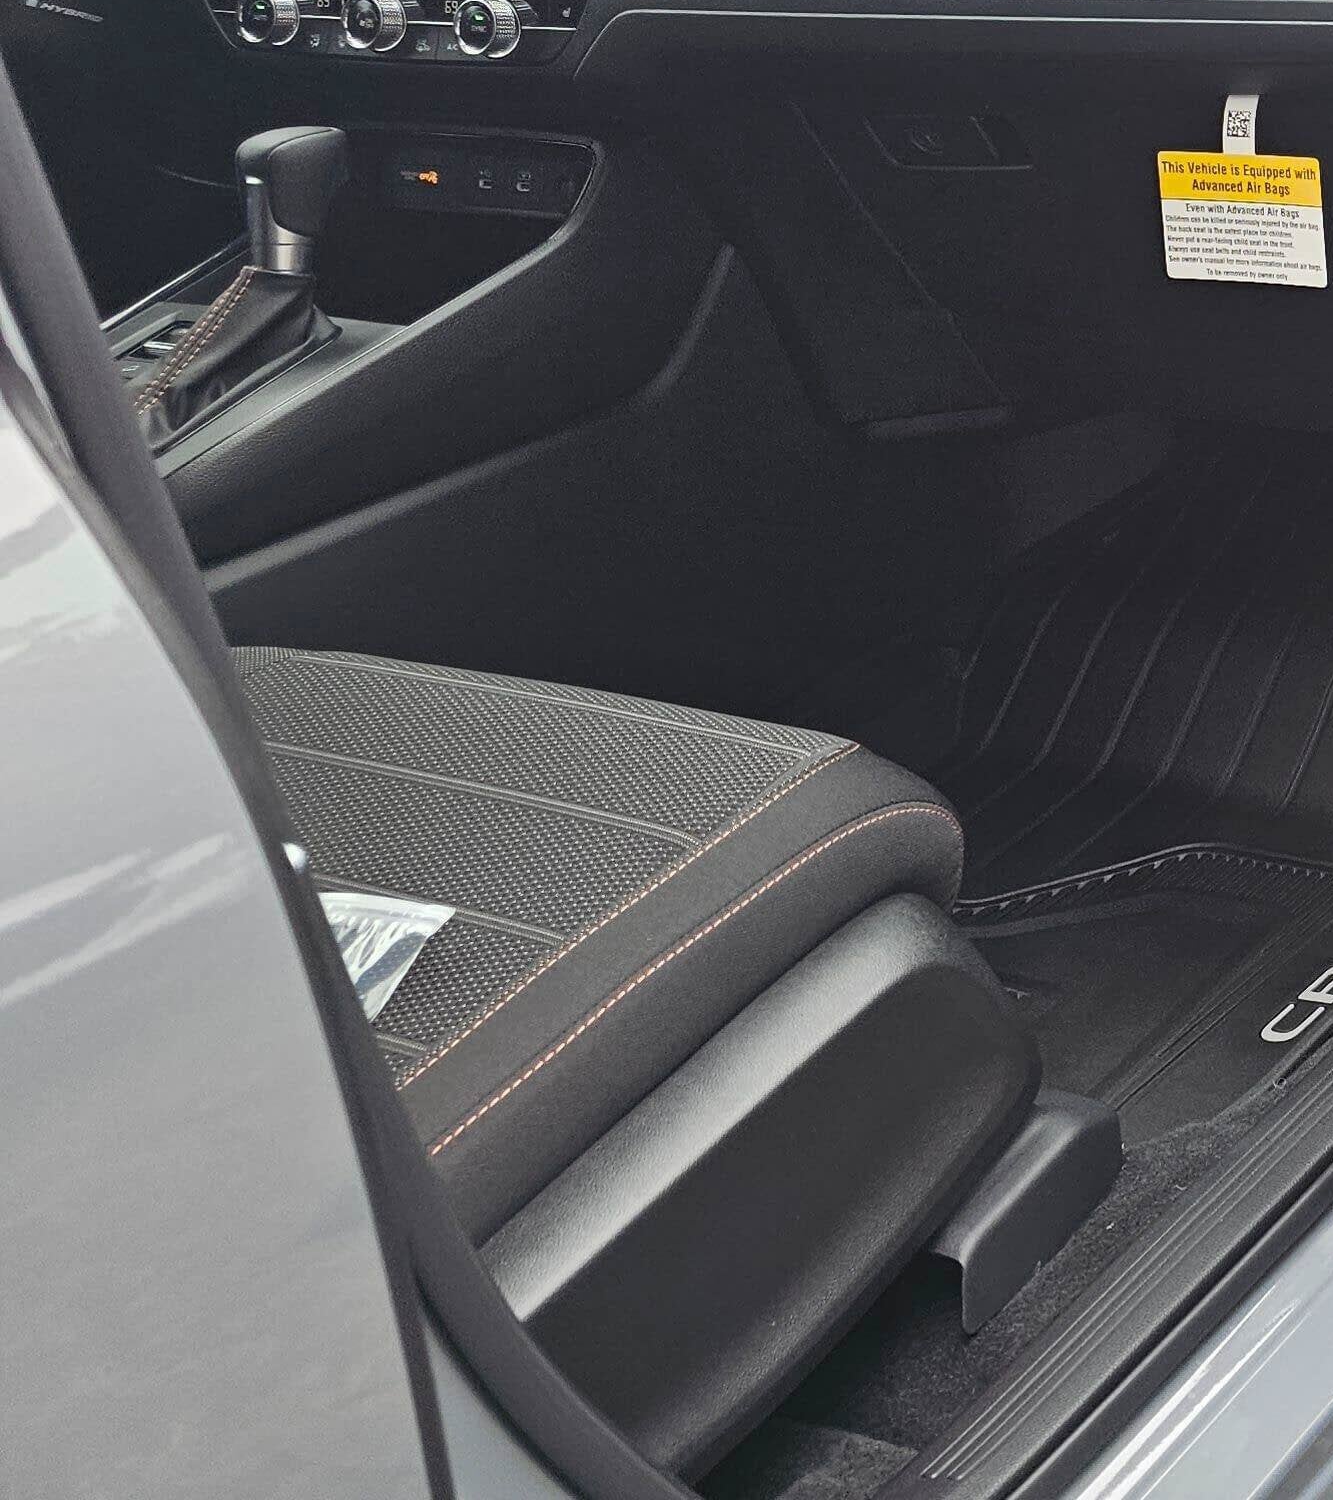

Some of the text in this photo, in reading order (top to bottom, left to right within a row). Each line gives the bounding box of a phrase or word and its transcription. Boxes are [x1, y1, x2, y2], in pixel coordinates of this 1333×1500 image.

[444, 0, 459, 14] 69
[1162, 161, 1316, 180] This Vehicle is Equipped with
[1192, 179, 1290, 197] Advanced Air Bags
[1185, 203, 1300, 219] Even with Advanced Air Bags
